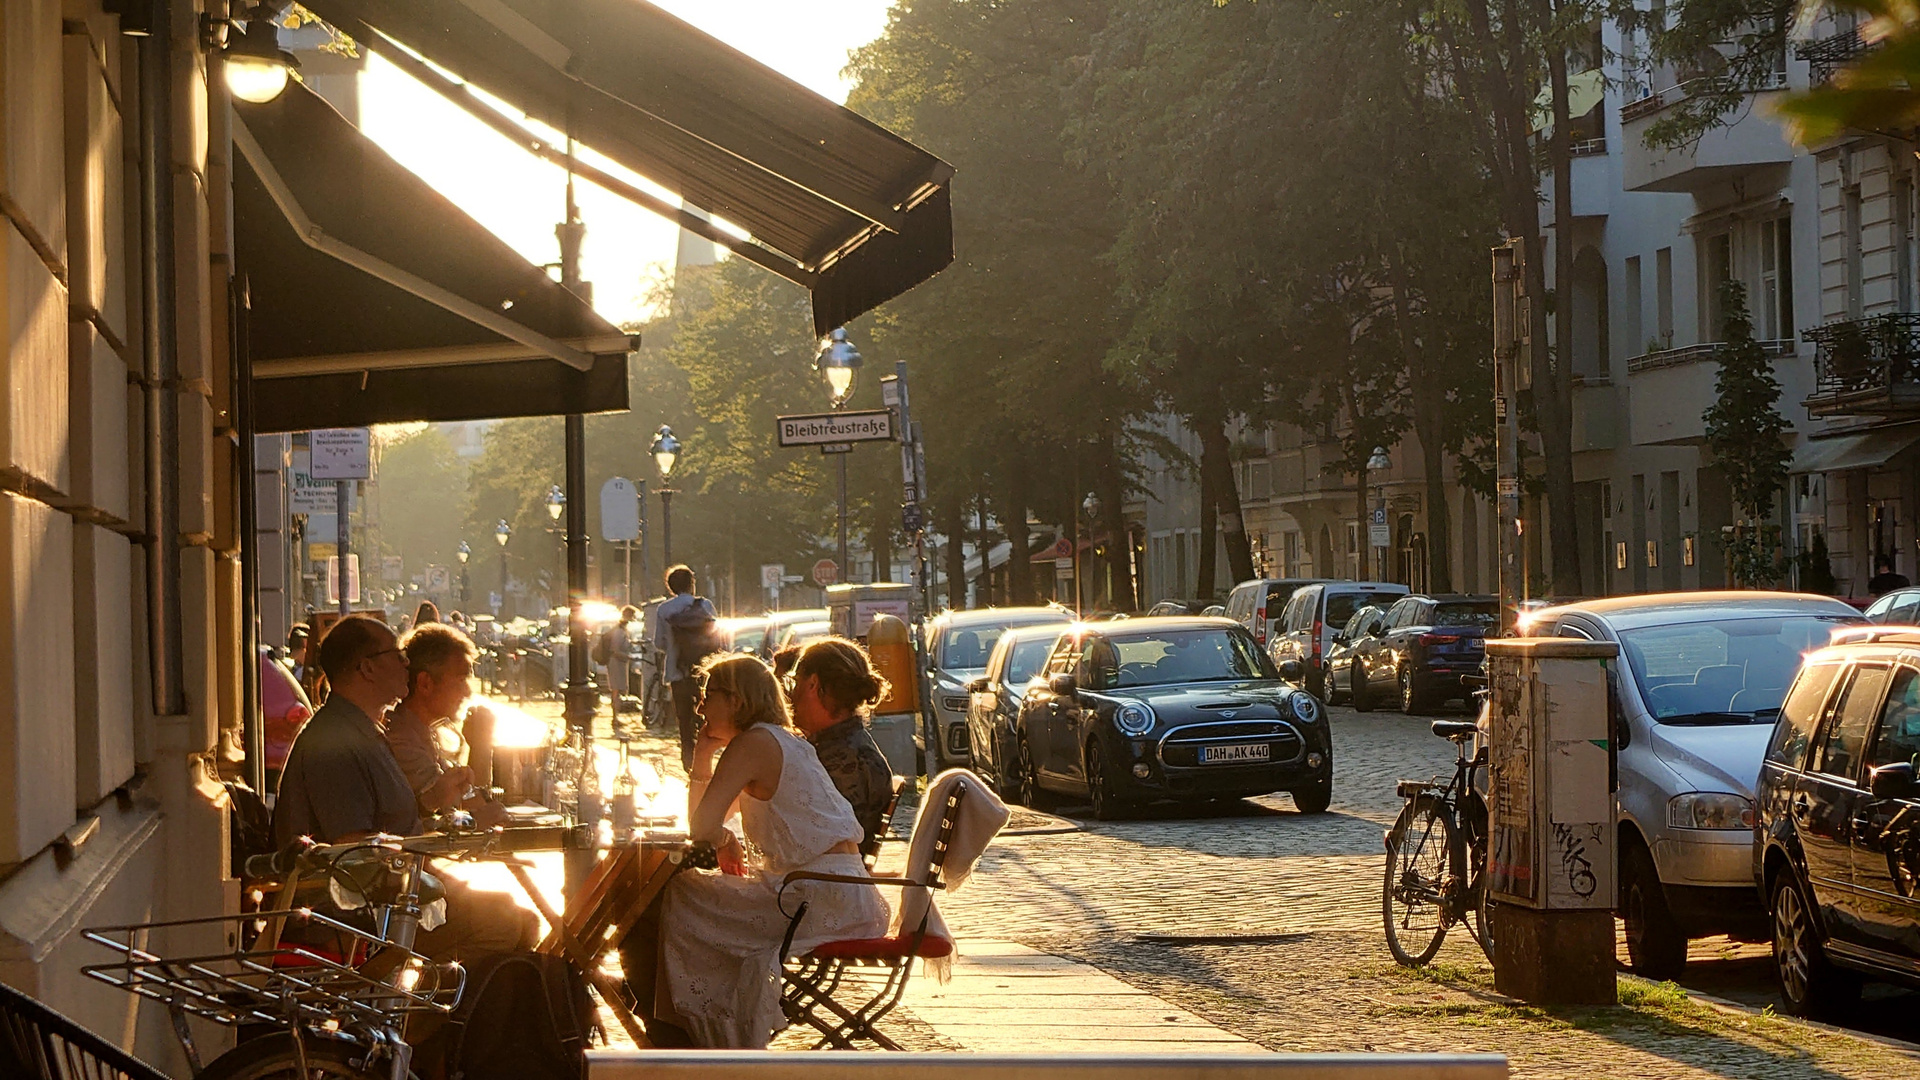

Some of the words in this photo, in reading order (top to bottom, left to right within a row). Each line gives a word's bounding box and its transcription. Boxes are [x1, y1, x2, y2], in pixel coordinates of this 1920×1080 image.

[785, 419, 887, 437] Bleibtreustraße
[815, 567, 837, 579] STOP
[1206, 747, 1227, 760] DAH
[1234, 746, 1248, 759] AK
[1249, 745, 1269, 757] 440
